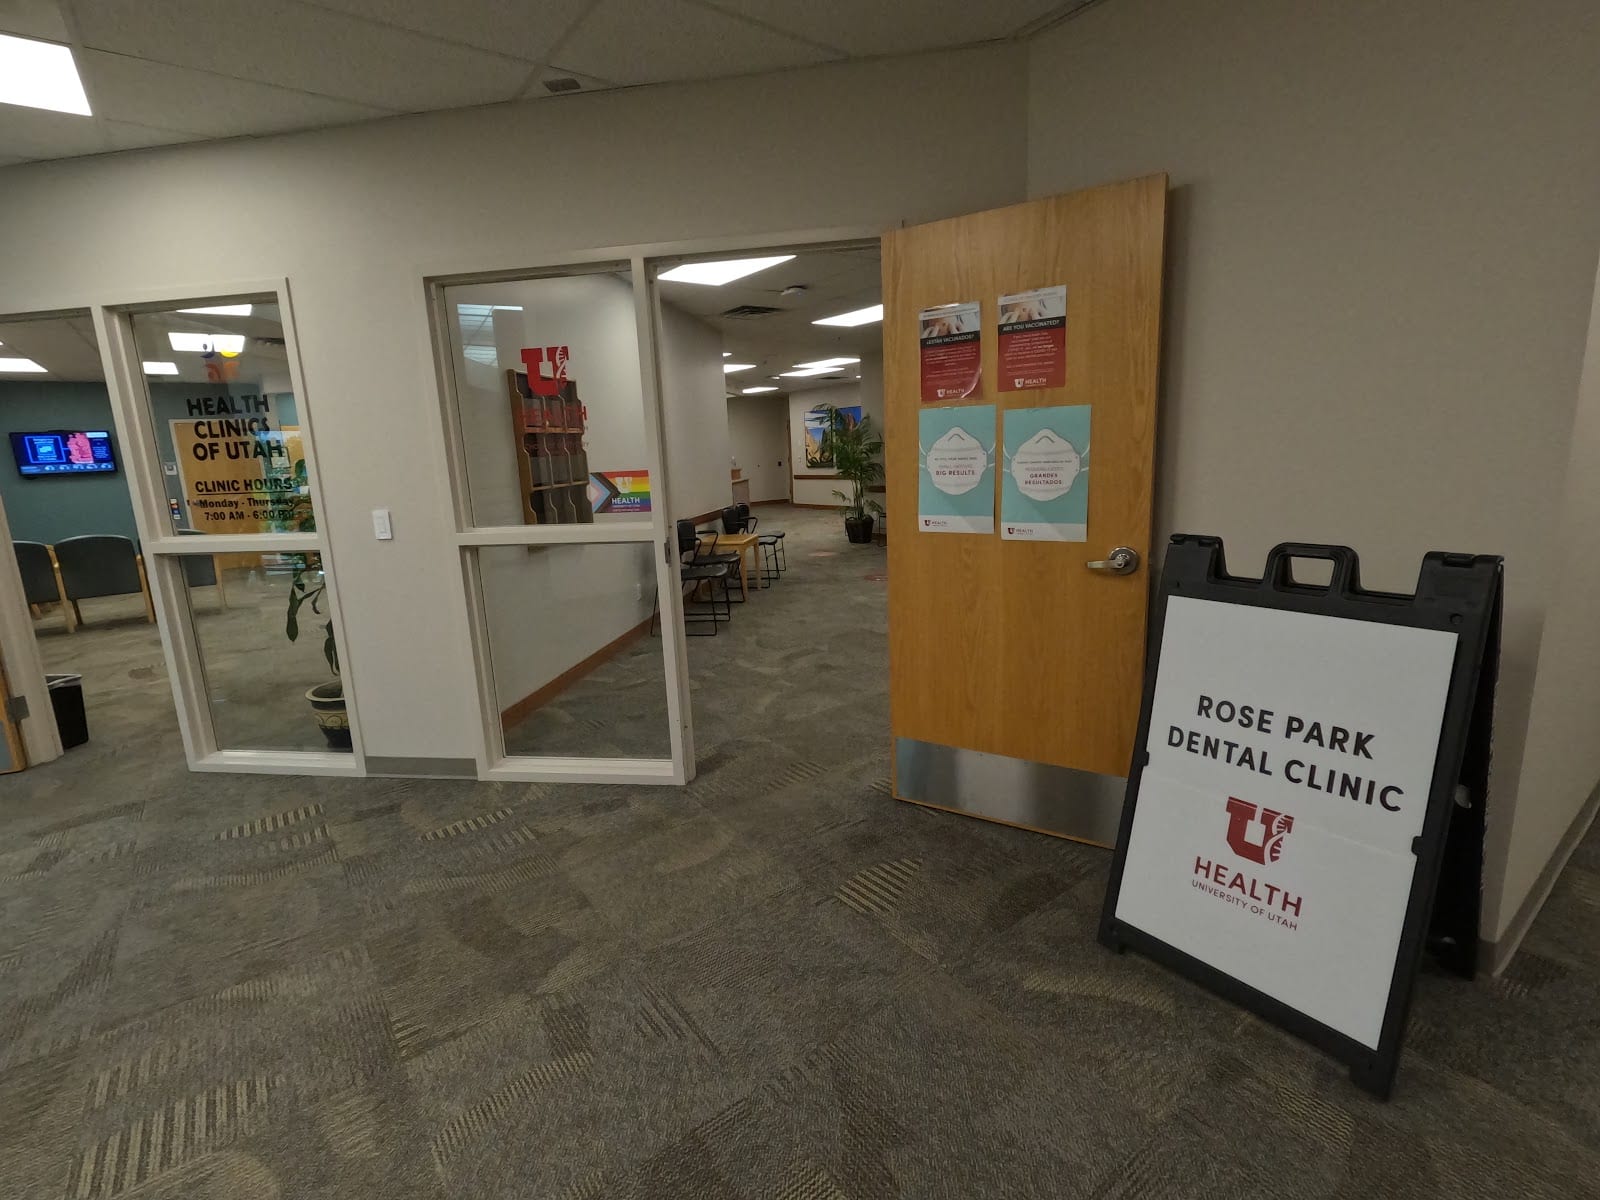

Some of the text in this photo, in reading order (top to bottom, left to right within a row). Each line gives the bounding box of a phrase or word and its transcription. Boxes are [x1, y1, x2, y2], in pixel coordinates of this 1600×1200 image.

[187, 395, 269, 415] HEALTH
[194, 417, 270, 439] CLINICS
[192, 439, 283, 461] OF UTAH
[195, 478, 293, 493] CLINIC HOURS
[199, 498, 239, 510] Monday
[611, 497, 641, 505] HEALTH
[204, 511, 226, 521] 7:00
[229, 511, 245, 521] AM
[253, 511, 275, 520] 6:00
[1197, 695, 1377, 760] ROSE PARK
[1167, 725, 1405, 812] DENTAL CLINIC
[1193, 856, 1303, 918] HEALTH
[1191, 879, 1298, 932] UNIVERSITY OF UTAH
